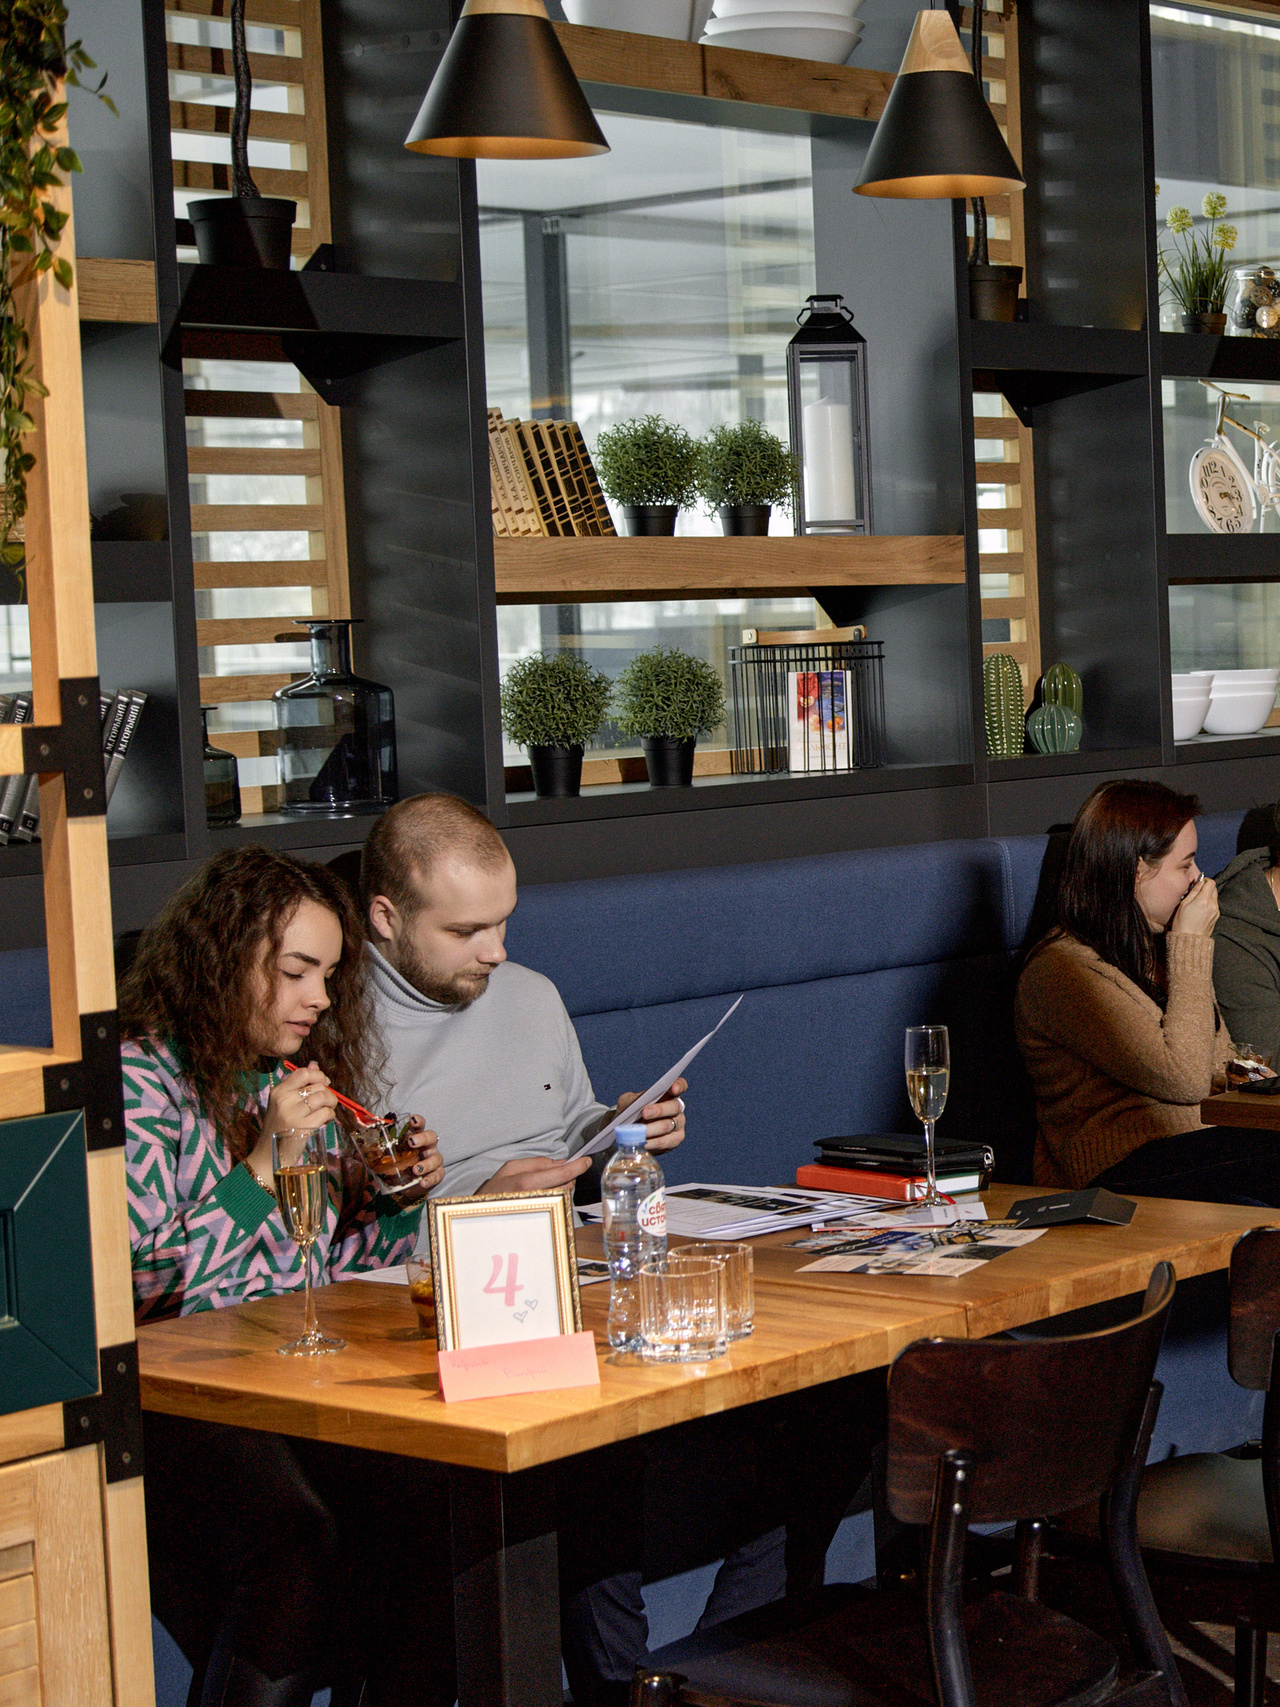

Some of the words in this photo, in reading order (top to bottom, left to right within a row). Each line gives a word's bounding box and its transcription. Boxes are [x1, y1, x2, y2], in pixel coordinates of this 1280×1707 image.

[495, 437, 513, 484] ГОНЧАРОВ
[505, 437, 523, 484] ГОНЧАРОВ
[1208, 462, 1218, 473] 12
[1202, 466, 1210, 477] 11
[1220, 466, 1226, 477] 1
[1228, 475, 1236, 488] 2
[1235, 489, 1242, 502] 3
[1226, 518, 1234, 533] 6
[106, 703, 127, 751] М.ГОРЬКИЙ
[118, 704, 140, 752] М.ГОРЬКИЙ
[642, 1215, 666, 1226] исто
[482, 1253, 524, 1307] 4
